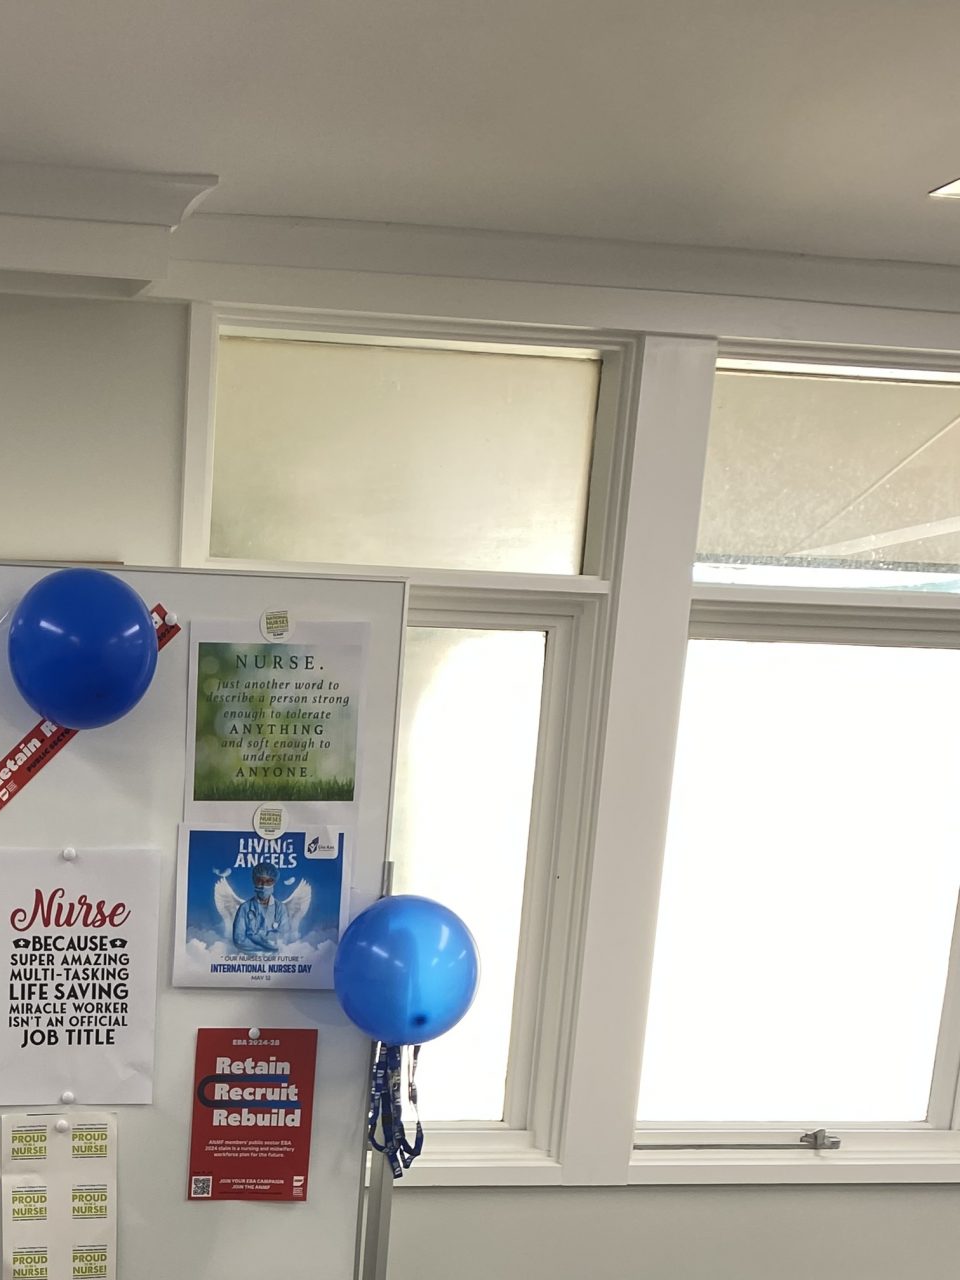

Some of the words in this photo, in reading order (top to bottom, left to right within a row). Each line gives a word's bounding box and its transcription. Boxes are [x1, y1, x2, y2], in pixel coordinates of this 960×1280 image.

[236, 654, 324, 670] NURSE.
[217, 679, 240, 691] just
[244, 679, 290, 690] another
[294, 680, 323, 690] word
[328, 681, 339, 690] to
[206, 692, 255, 702] describe
[269, 694, 308, 705] person
[312, 695, 350, 707] strong
[223, 709, 266, 720] enough
[271, 710, 281, 718] to
[286, 709, 331, 719] tolerate
[229, 724, 324, 735] ANYTHING
[221, 738, 243, 748] and
[247, 738, 269, 750] soft
[273, 739, 315, 750] enough
[319, 739, 331, 748] to
[242, 752, 309, 762] understand
[240, 838, 293, 854] LIVING
[234, 853, 297, 868] ANGELS
[10, 888, 131, 932] Nurse
[32, 935, 108, 951] BECAUSE
[10, 953, 55, 966] SUPER
[60, 953, 130, 966] AMAZING
[10, 967, 129, 981] MULTI-TASKING
[210, 963, 267, 973] INTERNATIONAL
[268, 964, 296, 973] NURSES
[297, 964, 312, 973] DAY
[9, 983, 49, 1000] LIFE
[54, 982, 129, 1000] SAVING
[9, 1002, 67, 1014] MIRACLE
[72, 1002, 128, 1014] WORKER
[9, 1015, 41, 1027] ISN'T
[46, 1015, 64, 1027] AN
[69, 1015, 128, 1027] OFFICIAL
[21, 1029, 59, 1048] JOB
[65, 1029, 115, 1045] TITLE
[216, 1057, 290, 1075] Retain
[214, 1083, 298, 1101] Recruit
[212, 1109, 301, 1127] Rebuild
[12, 1134, 47, 1143] PROUD
[12, 1146, 47, 1155] NURSE!
[72, 1253, 107, 1263] PROUD
[72, 1265, 107, 1274] NURSE!
